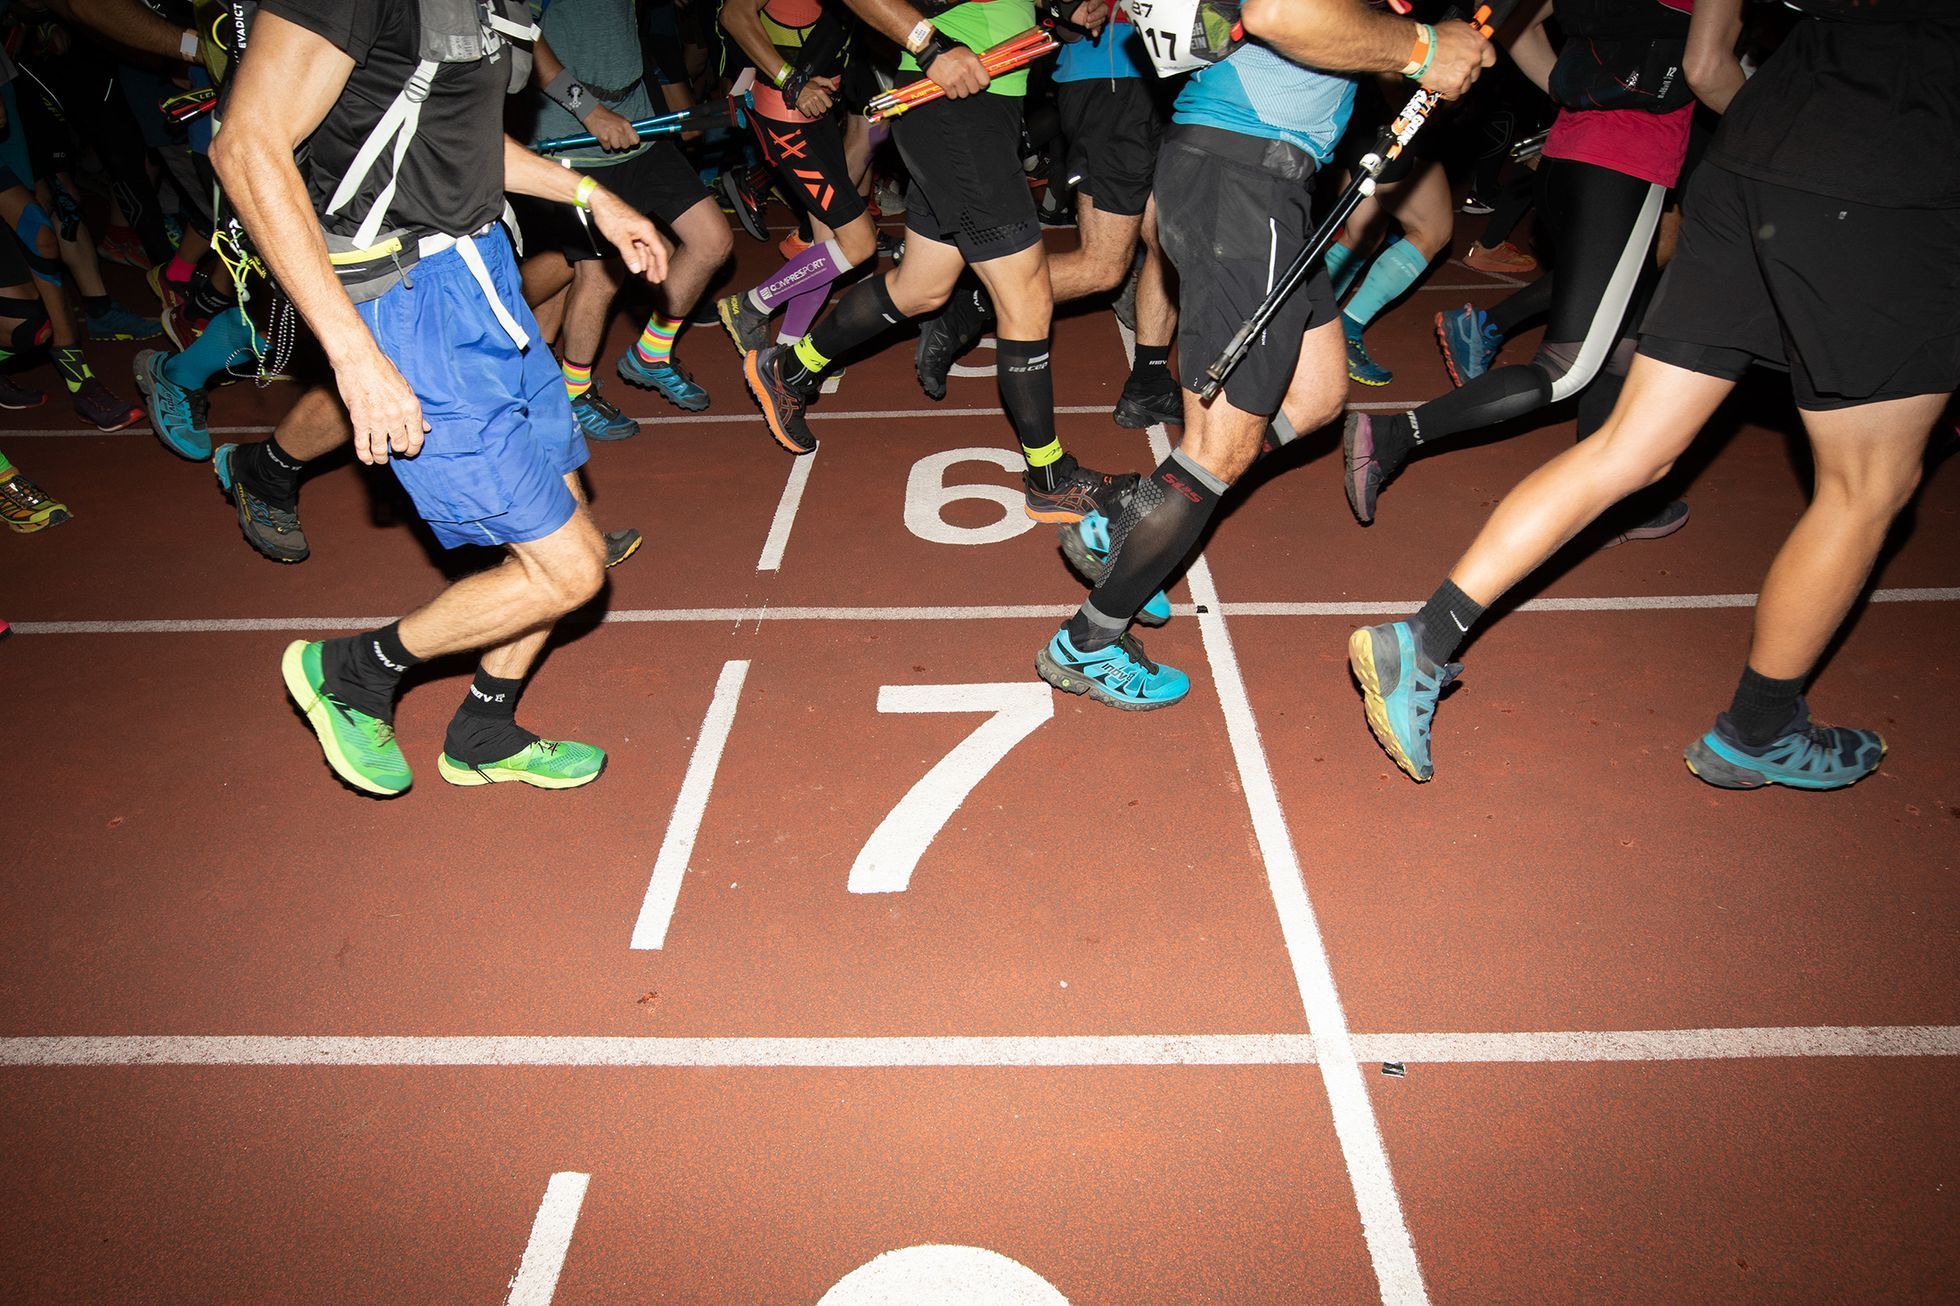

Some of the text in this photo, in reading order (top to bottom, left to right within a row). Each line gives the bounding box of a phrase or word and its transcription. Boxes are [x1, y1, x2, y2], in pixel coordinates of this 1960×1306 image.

[233, 3, 247, 49] EVADICT
[903, 446, 1038, 546] 6
[847, 682, 1055, 895] 7
